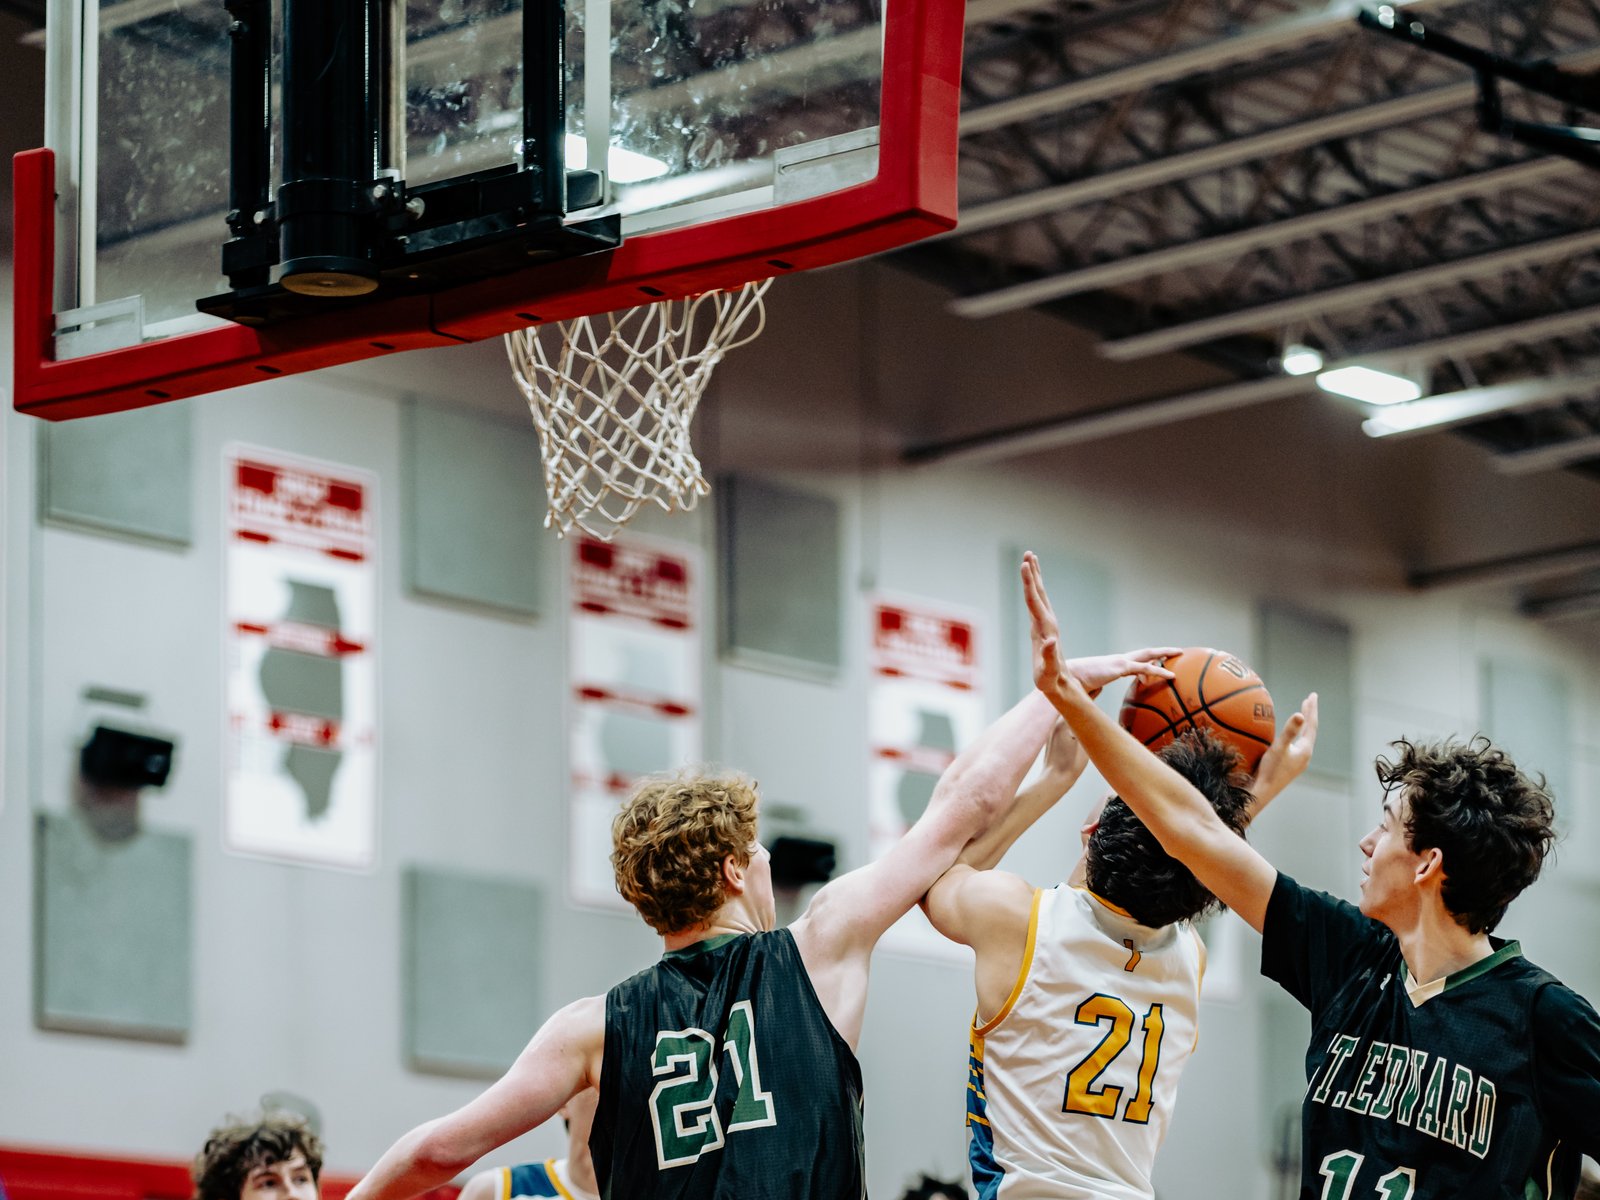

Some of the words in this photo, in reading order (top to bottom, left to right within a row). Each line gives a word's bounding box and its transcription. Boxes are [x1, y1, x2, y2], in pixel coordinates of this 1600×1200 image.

[649, 999, 777, 1171] 21
[1062, 992, 1165, 1125] 21
[1302, 1032, 1497, 1160] T.EDWARD
